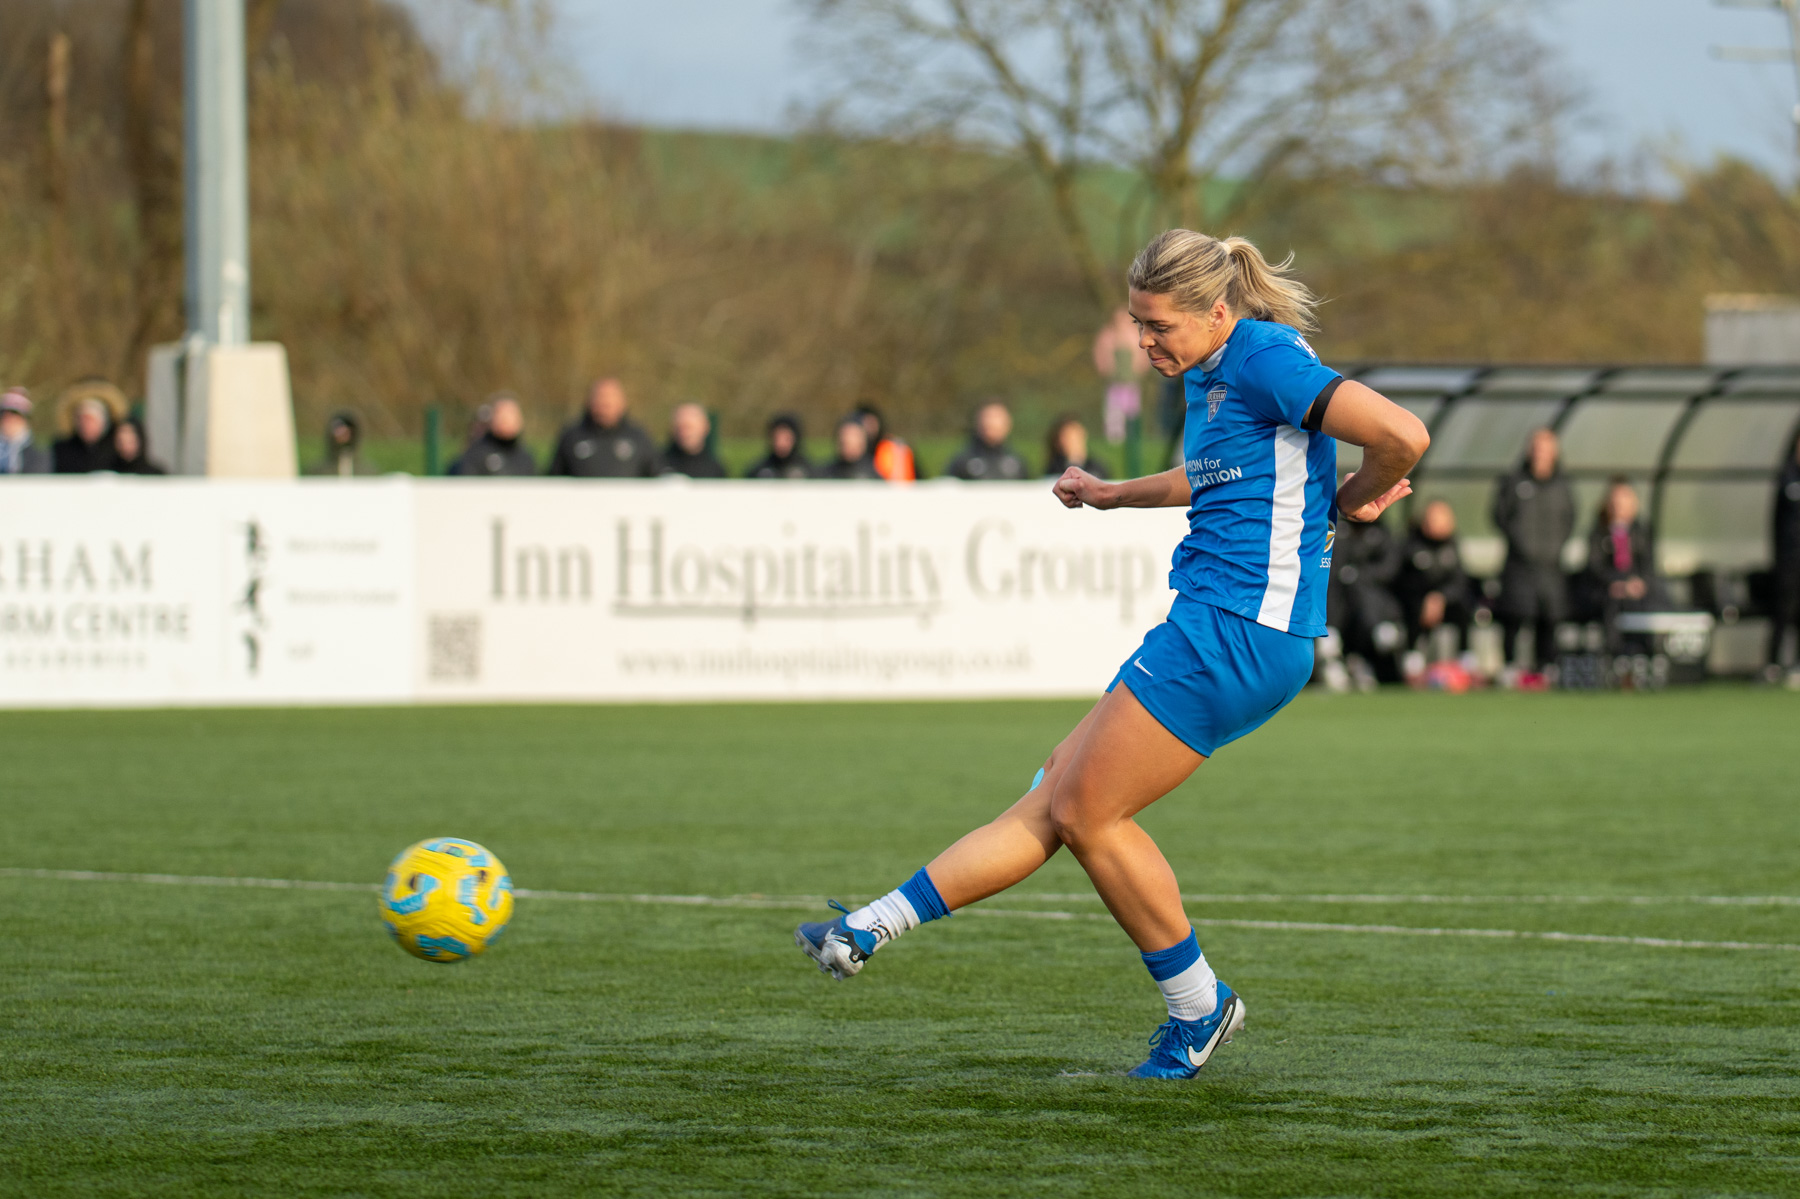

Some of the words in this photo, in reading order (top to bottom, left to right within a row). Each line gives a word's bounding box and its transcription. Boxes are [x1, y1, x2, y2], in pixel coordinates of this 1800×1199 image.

[1204, 457, 1222, 471] for
[0, 538, 154, 591] HAM
[489, 515, 594, 602] Inn
[613, 515, 943, 629] Hospitality
[964, 517, 1156, 624] Group
[0, 603, 56, 641] RM
[63, 603, 192, 642] CENTRE
